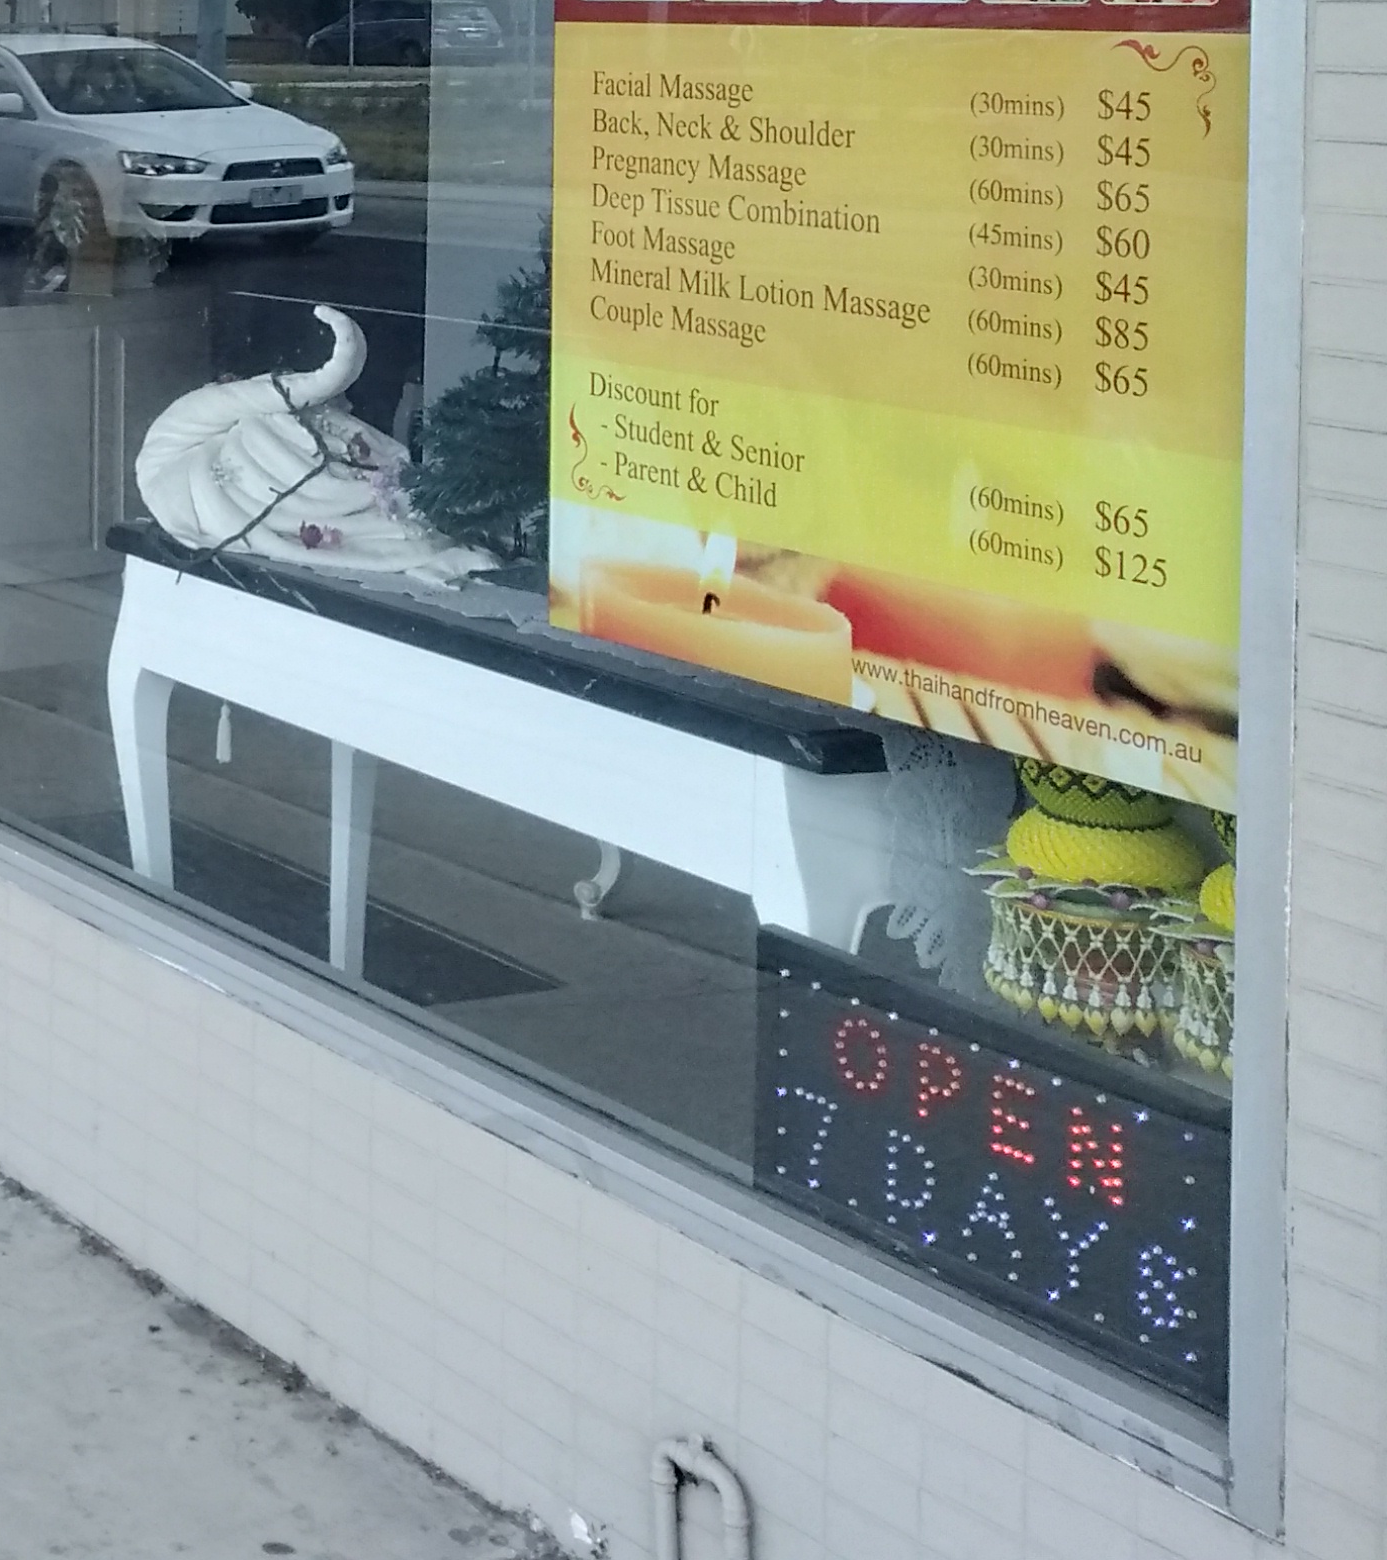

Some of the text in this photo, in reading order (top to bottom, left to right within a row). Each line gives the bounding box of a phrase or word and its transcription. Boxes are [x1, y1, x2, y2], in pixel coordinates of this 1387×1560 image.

[592, 70, 1152, 124] Facial Massage (30mins) $45
[592, 108, 1151, 169] Back, Neck & Shoulder (30mins) $45
[591, 183, 1150, 261] Deep Tissue Combination (45mins) $60
[592, 146, 1150, 215] Pregnancy Massage (60mins) $65
[590, 258, 1149, 353] Mineral Milk Lotion Massage (60mins) $85
[591, 220, 1150, 306] Foot Massage (30mins) $45
[588, 370, 720, 418] Discount for
[589, 295, 1149, 399] Couple Massage (60mins) $65
[613, 414, 695, 454] Student
[701, 430, 724, 458] &
[730, 433, 806, 474] Senior
[968, 484, 1065, 526] (60mins)
[1094, 498, 1150, 539] $65
[613, 450, 681, 488] Parent
[686, 465, 708, 493] &
[714, 470, 778, 509] Child
[968, 528, 1065, 571] (60mins)
[1094, 543, 1168, 589] $125
[851, 654, 1204, 765] www.thaihandfromheaven.com.au
[795, 1086, 839, 1189] 7
[833, 1015, 1124, 1207] OPEN
